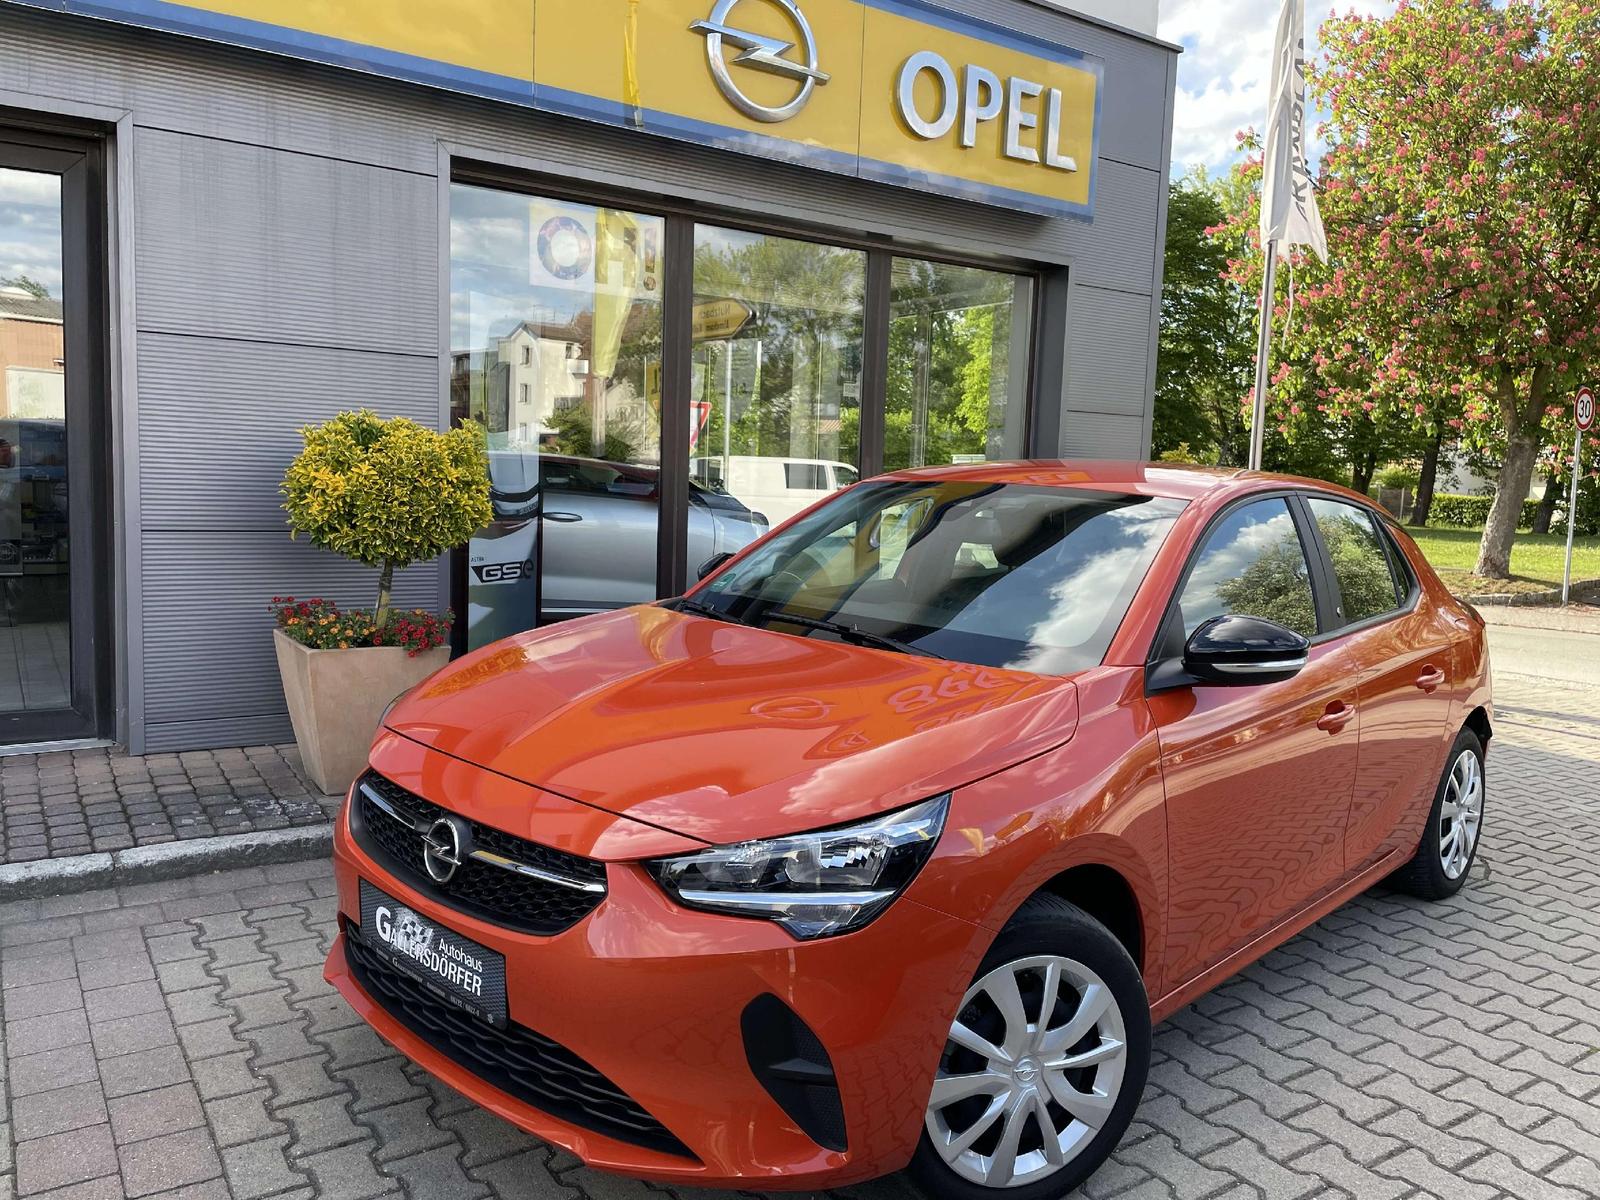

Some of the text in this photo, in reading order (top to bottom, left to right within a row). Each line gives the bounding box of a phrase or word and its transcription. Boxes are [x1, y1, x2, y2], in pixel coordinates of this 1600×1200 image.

[897, 50, 1077, 172] OPEL
[1578, 399, 1591, 419] 30
[375, 906, 482, 997] GALLERSDÖRFER
[438, 938, 483, 973] Autohaus
